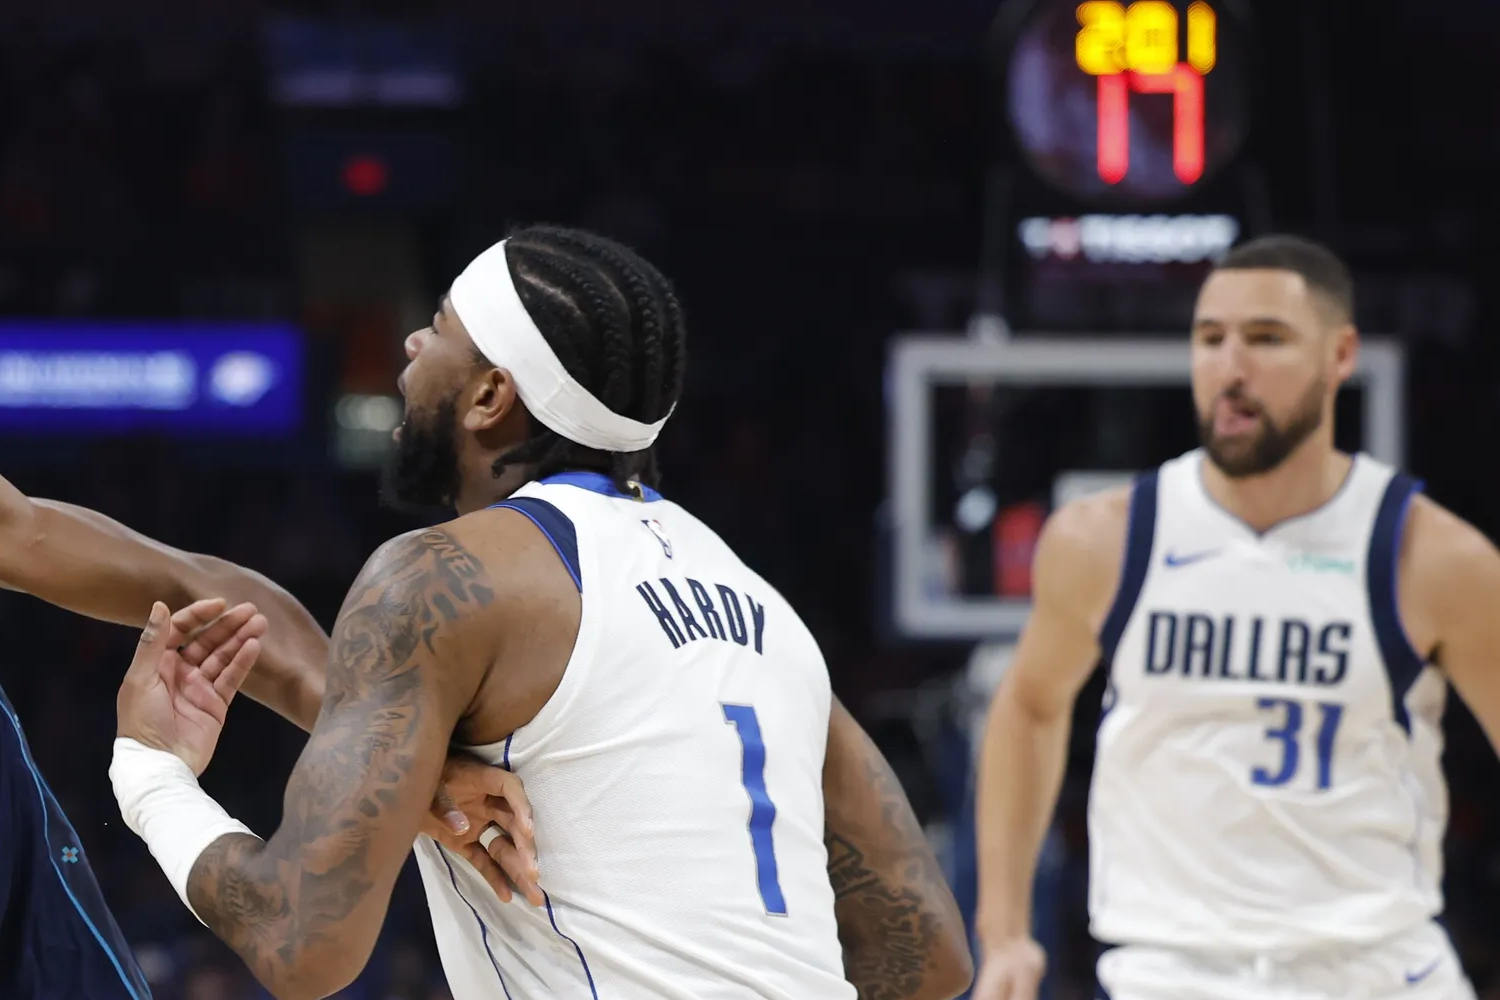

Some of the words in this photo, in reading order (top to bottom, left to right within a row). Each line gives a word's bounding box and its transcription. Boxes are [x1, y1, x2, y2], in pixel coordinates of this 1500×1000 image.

[636, 577, 765, 655] HARDY
[1144, 609, 1355, 686] DALLAS
[1250, 697, 1346, 790] 31
[720, 701, 788, 917] 1
